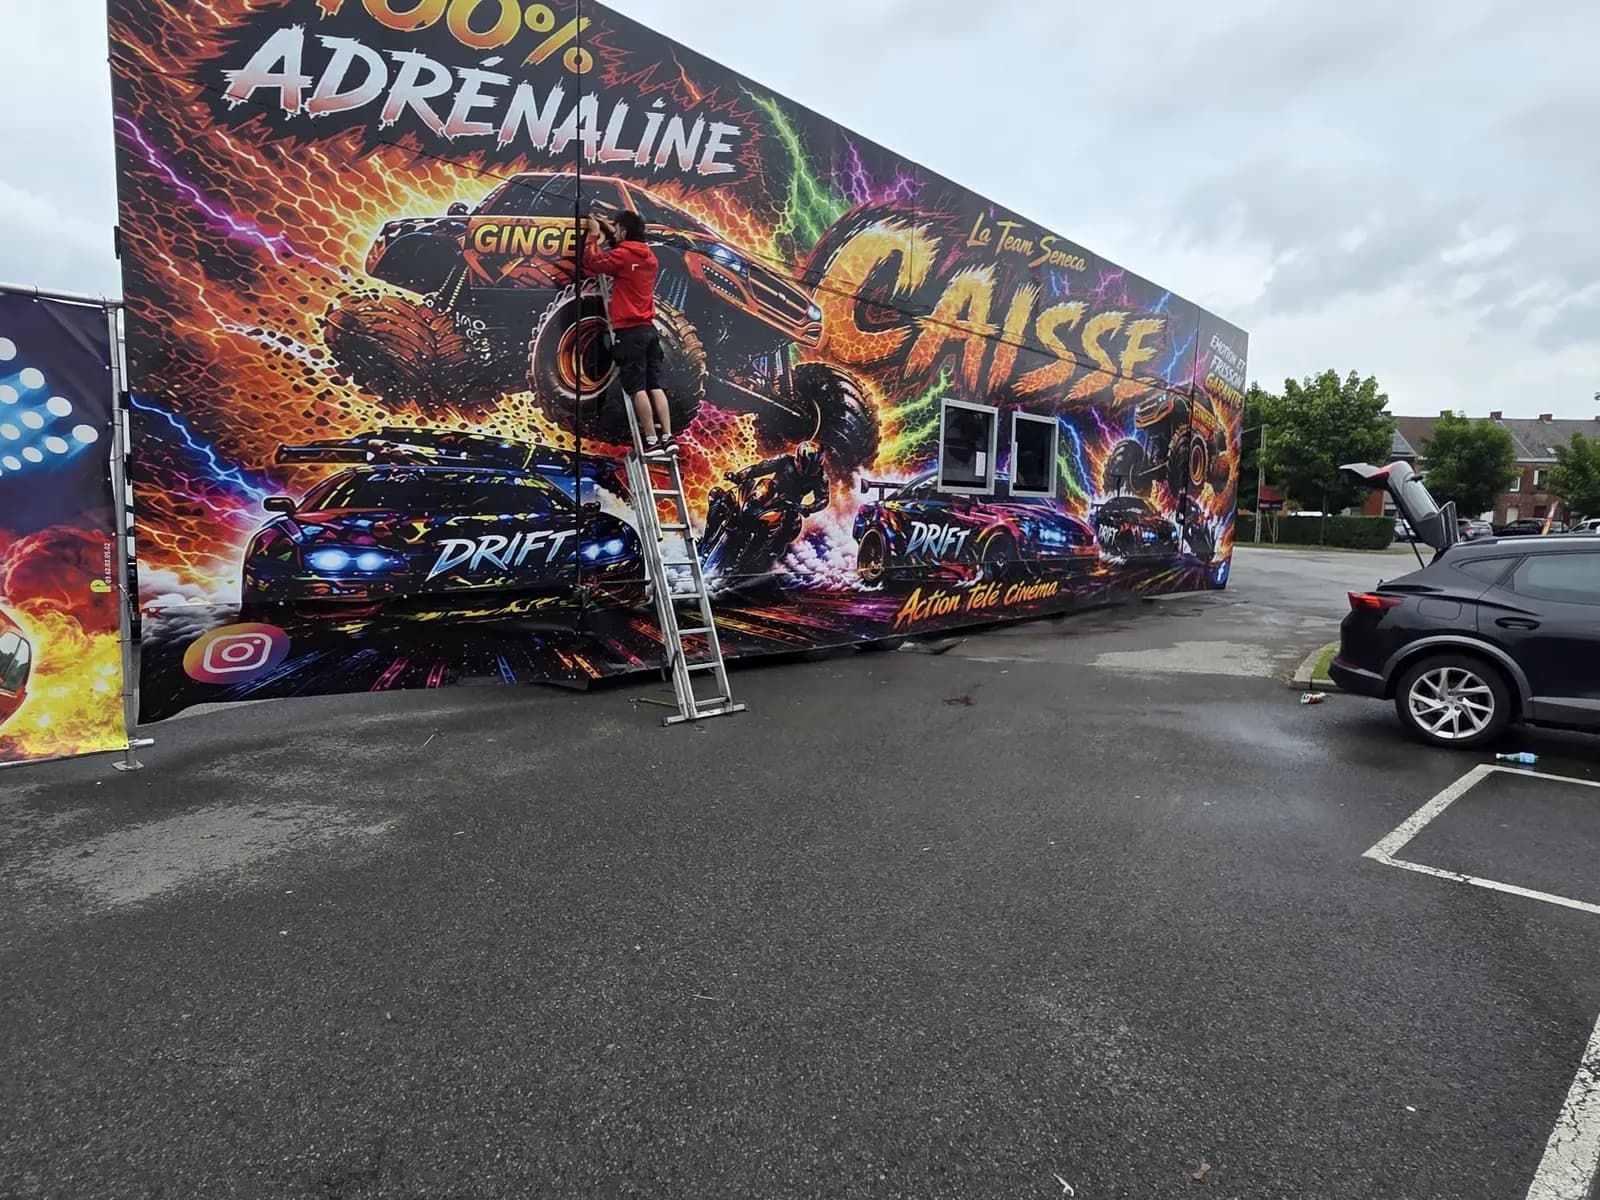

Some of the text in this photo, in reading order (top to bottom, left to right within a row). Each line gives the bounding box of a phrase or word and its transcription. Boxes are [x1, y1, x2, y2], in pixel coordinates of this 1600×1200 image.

[474, 224, 606, 258] GINGE
[966, 212, 1086, 272] La Team Seneca
[811, 215, 1168, 406] CAISSE
[1209, 354, 1244, 390] FRISSON
[1236, 358, 1246, 376] ET
[904, 521, 971, 560] DRIFT
[1099, 523, 1119, 546] DRIFT
[425, 529, 577, 582] DRIFT
[893, 586, 961, 630] Action
[1003, 578, 1058, 606] Cinéma
